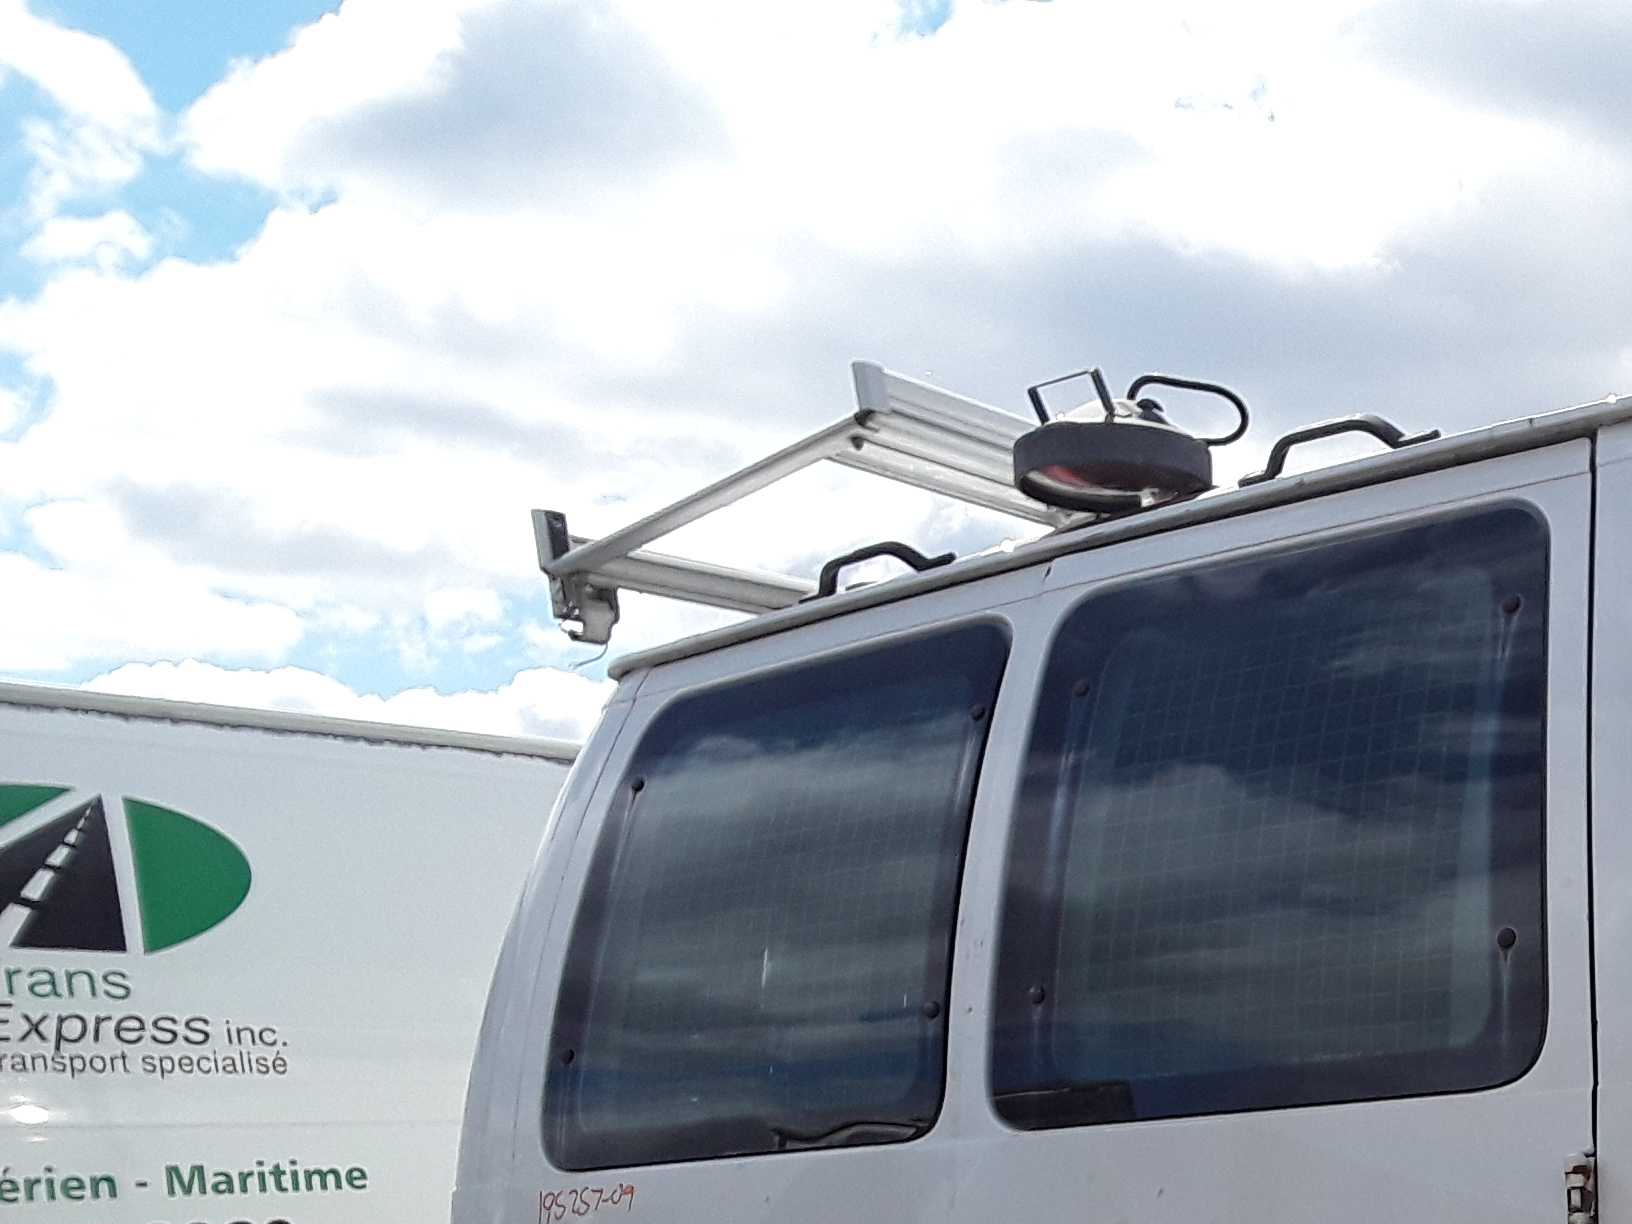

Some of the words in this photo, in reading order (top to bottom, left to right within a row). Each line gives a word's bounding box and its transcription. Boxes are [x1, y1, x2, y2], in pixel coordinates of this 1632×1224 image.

[225, 1020, 288, 1047] inc.
[141, 1049, 288, 1079] specialisé
[165, 1160, 368, 1197] Maritime
